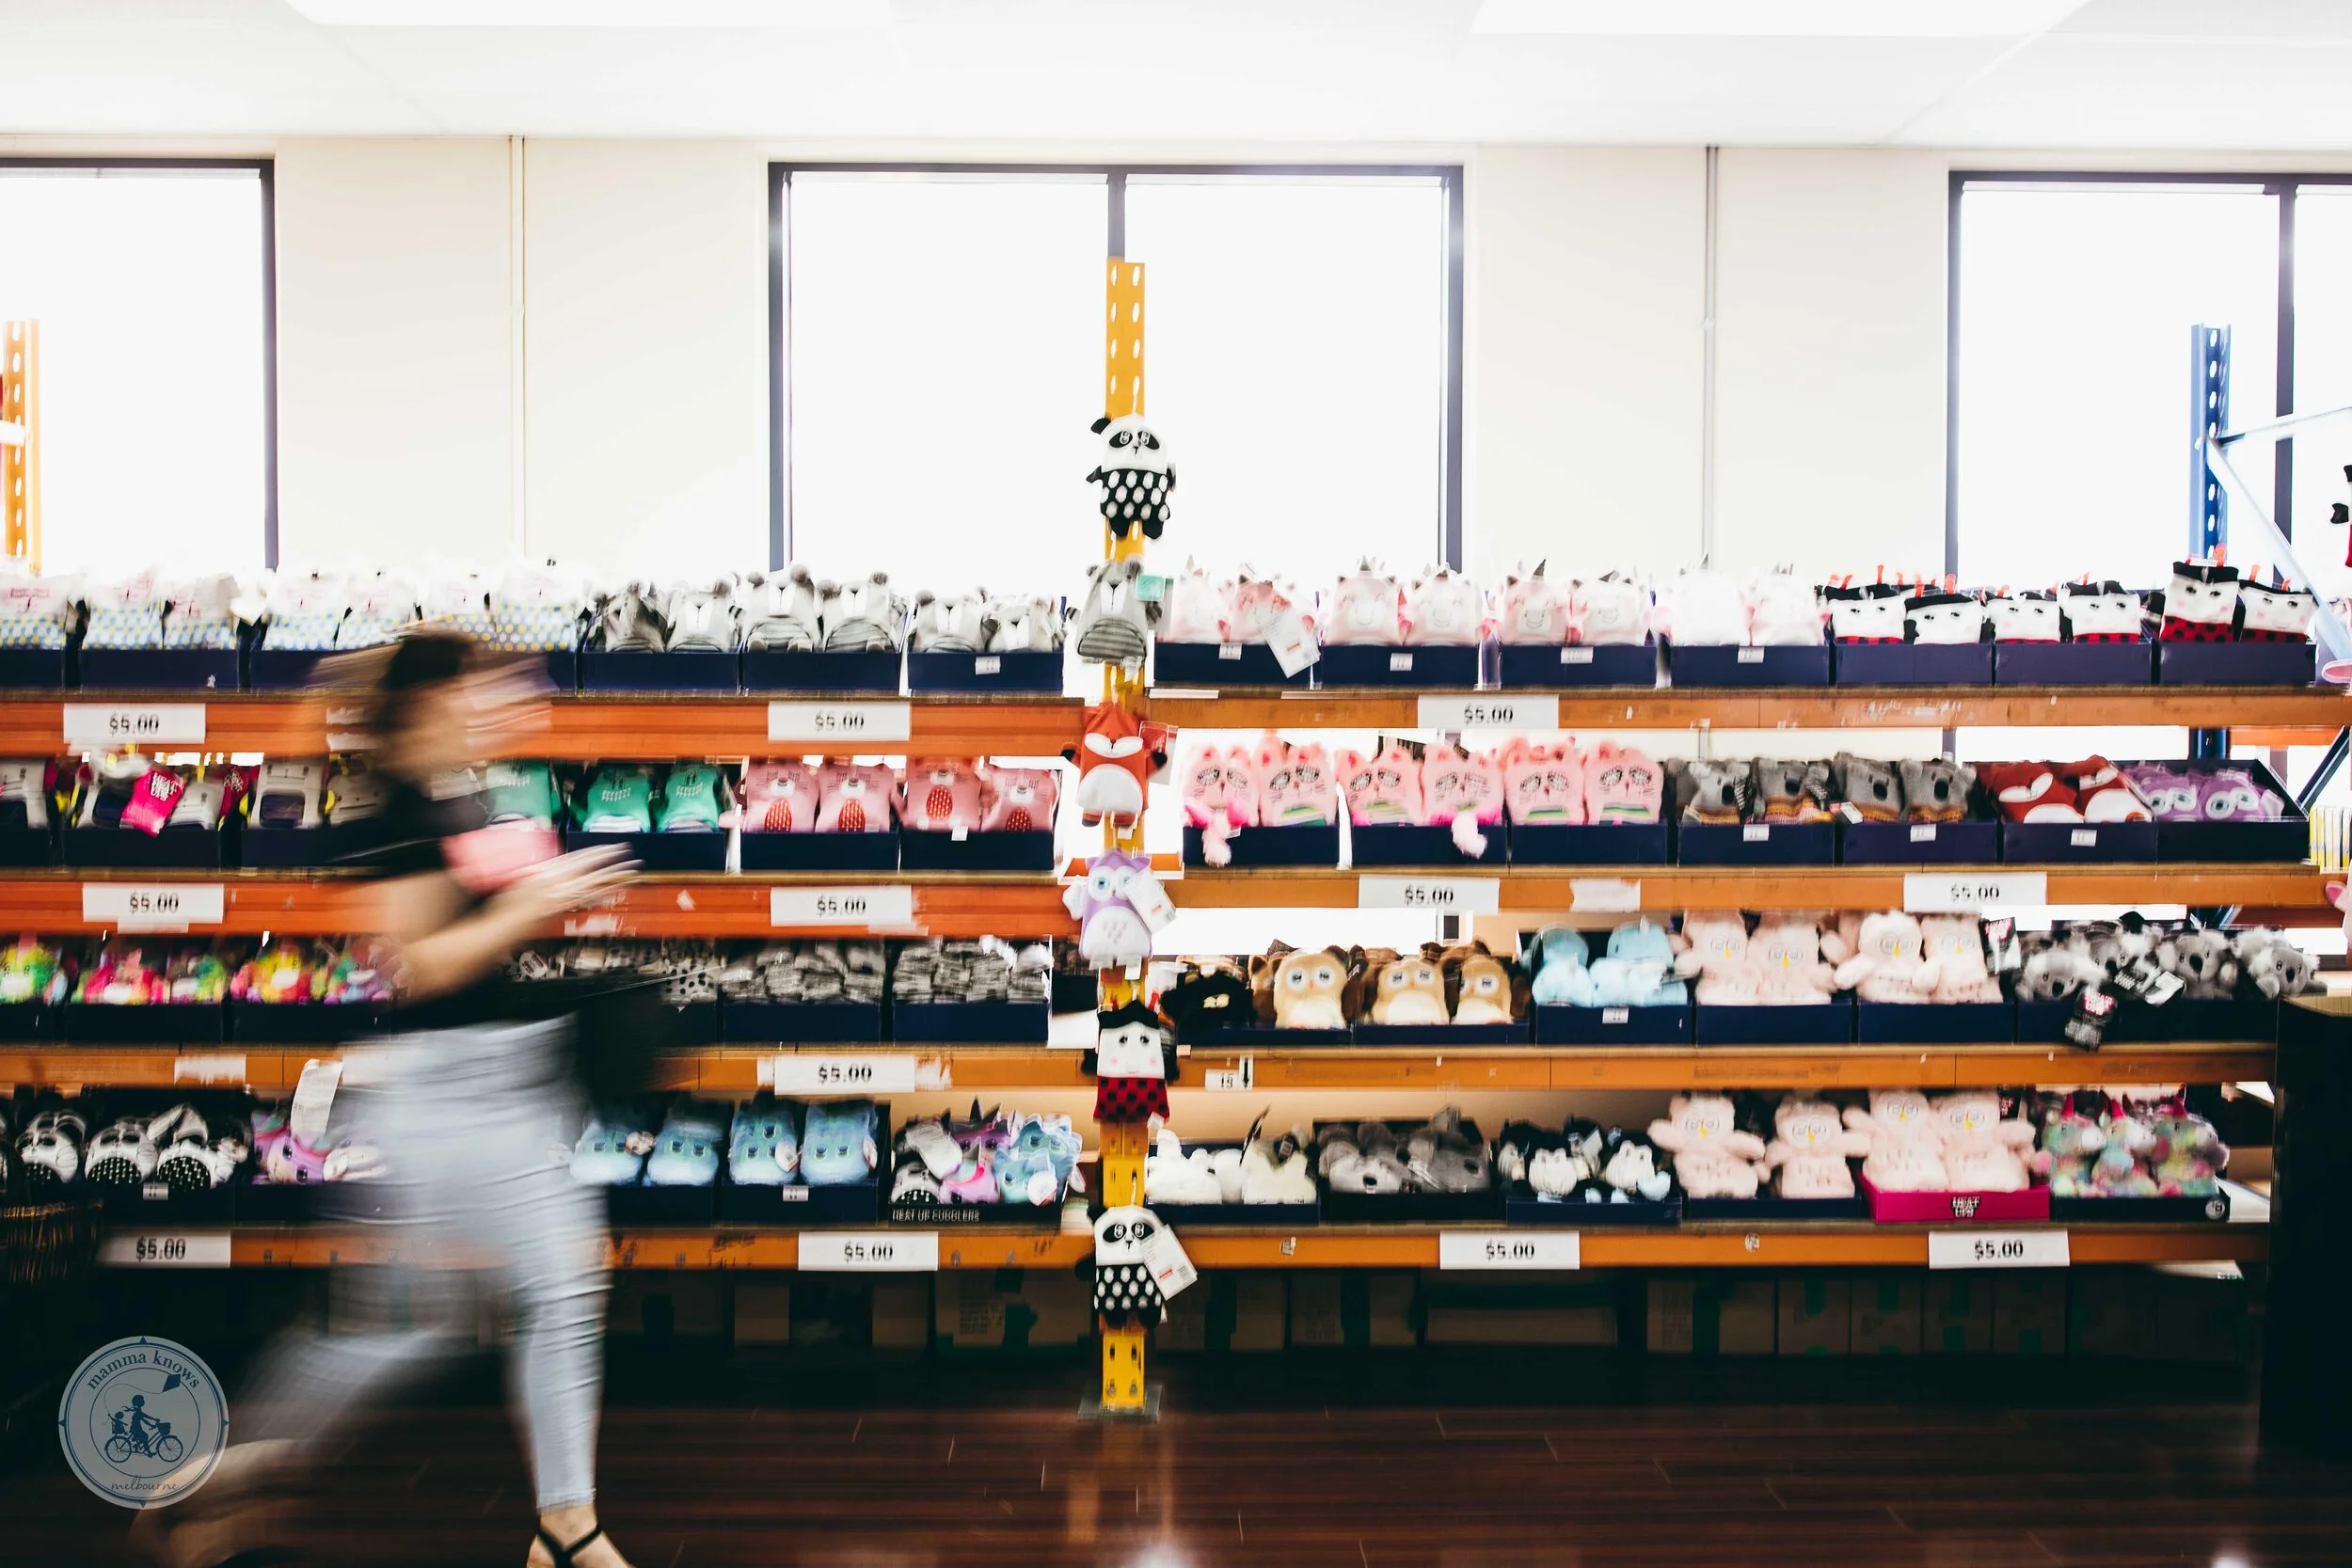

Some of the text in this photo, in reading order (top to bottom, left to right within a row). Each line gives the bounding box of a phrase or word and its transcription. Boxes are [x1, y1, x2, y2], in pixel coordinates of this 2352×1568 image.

[109, 713, 159, 736] $5.00
[815, 712, 865, 733] $5.00
[1464, 704, 1514, 726] $5.00
[129, 892, 179, 915] $5.00
[1404, 885, 1454, 907] $5.00
[1950, 882, 2000, 903] $5.00
[817, 895, 866, 917] $5.00
[818, 1063, 872, 1085] $5.00
[135, 1236, 186, 1261] $5.00
[844, 1243, 894, 1263] $5.00
[1486, 1241, 1535, 1261] $5.00
[1974, 1240, 2024, 1261] $5.00
